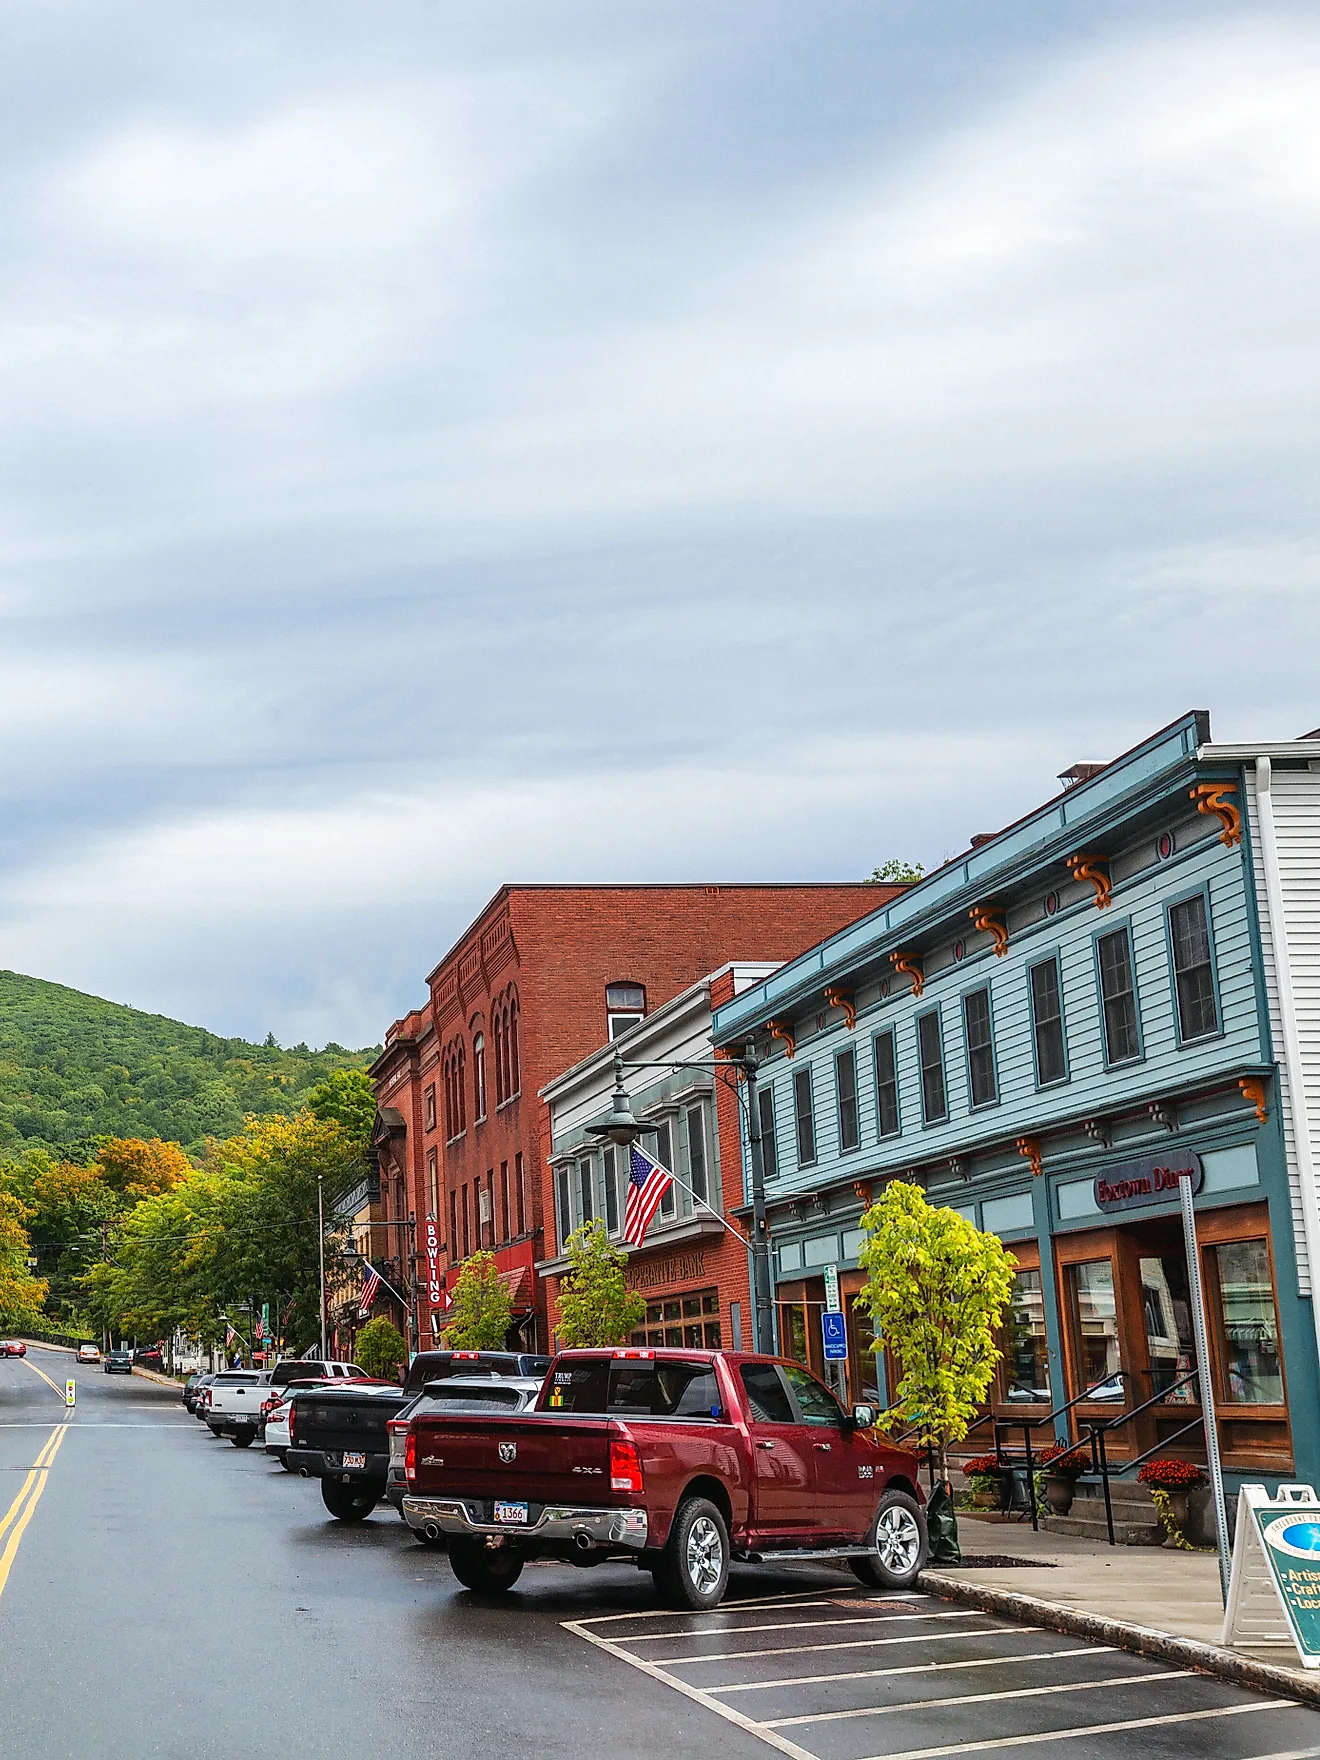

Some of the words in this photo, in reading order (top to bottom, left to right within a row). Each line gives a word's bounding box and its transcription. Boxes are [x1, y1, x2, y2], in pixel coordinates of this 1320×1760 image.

[1097, 1177, 1152, 1203] Foxtown
[427, 1225, 440, 1303] BOWLING
[679, 1252, 706, 1280] BANK
[502, 1507, 523, 1519] 1366
